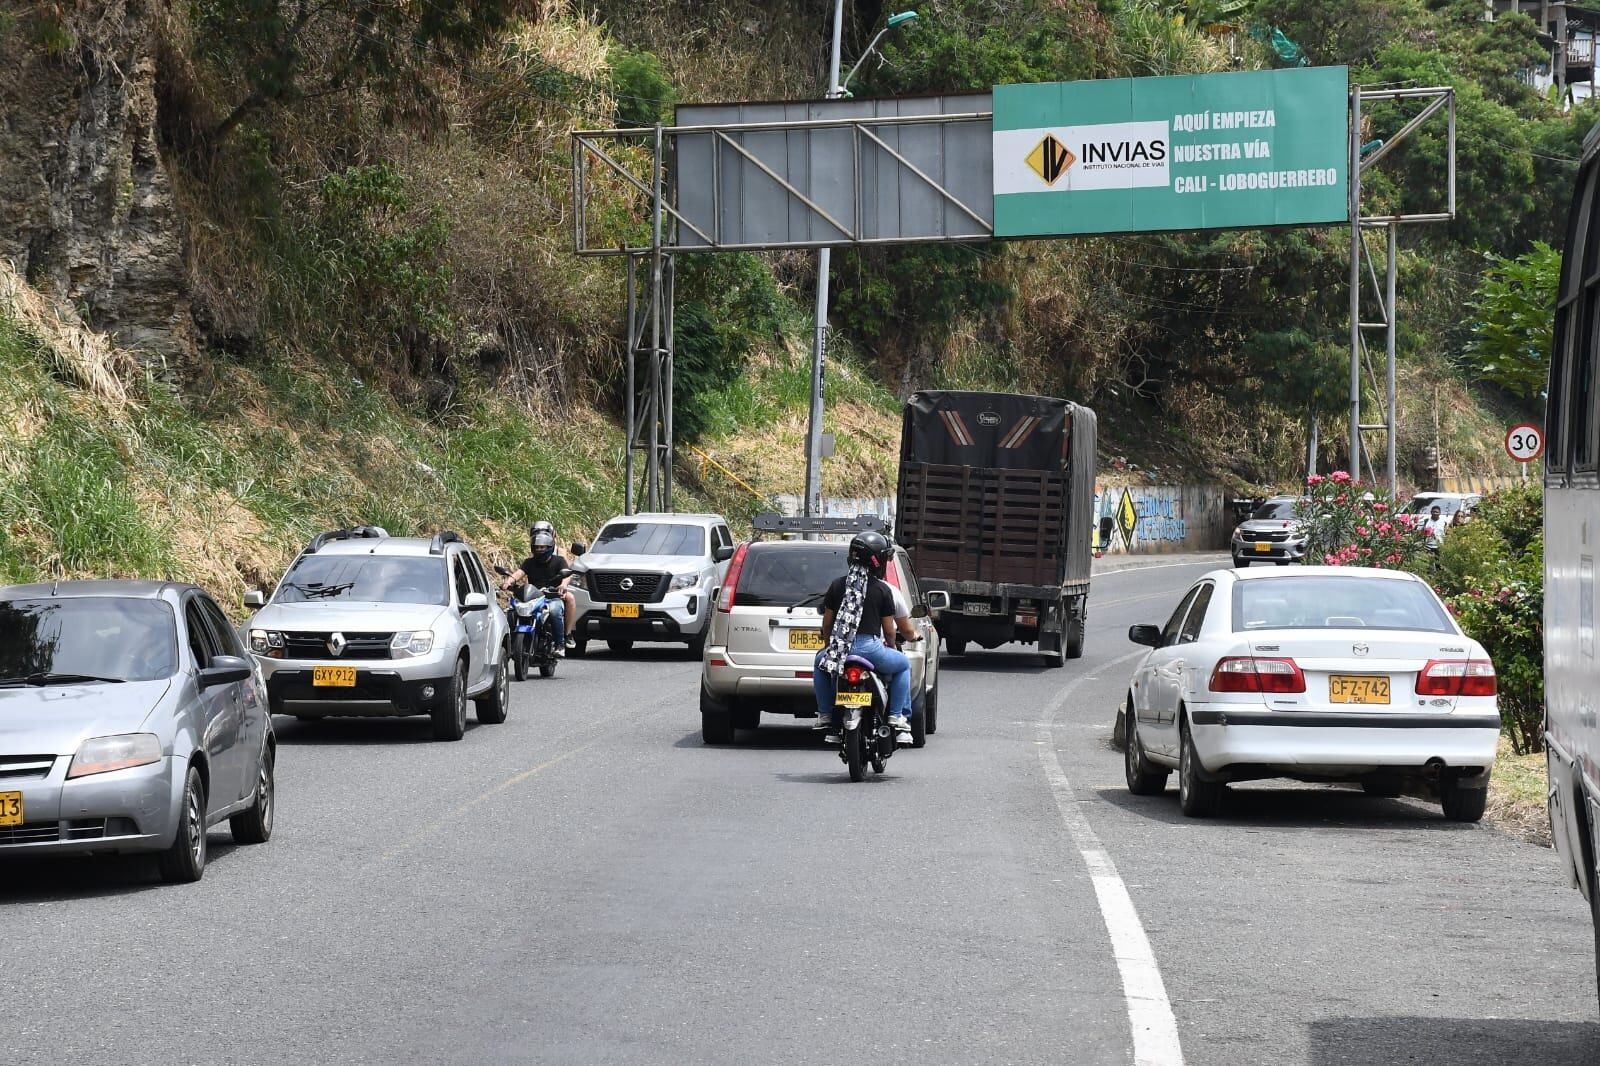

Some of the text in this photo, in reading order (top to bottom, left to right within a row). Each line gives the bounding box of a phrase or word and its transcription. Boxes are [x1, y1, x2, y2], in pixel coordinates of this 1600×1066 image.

[1173, 110, 1275, 132] AQUÍ EMPIEZA
[1082, 140, 1166, 163] INVIAS
[1174, 139, 1271, 163] NUESTRA VÍA
[1174, 175, 1207, 193] CALI
[1219, 168, 1337, 191] LOBOGUERRERO
[1512, 434, 1538, 450] 30
